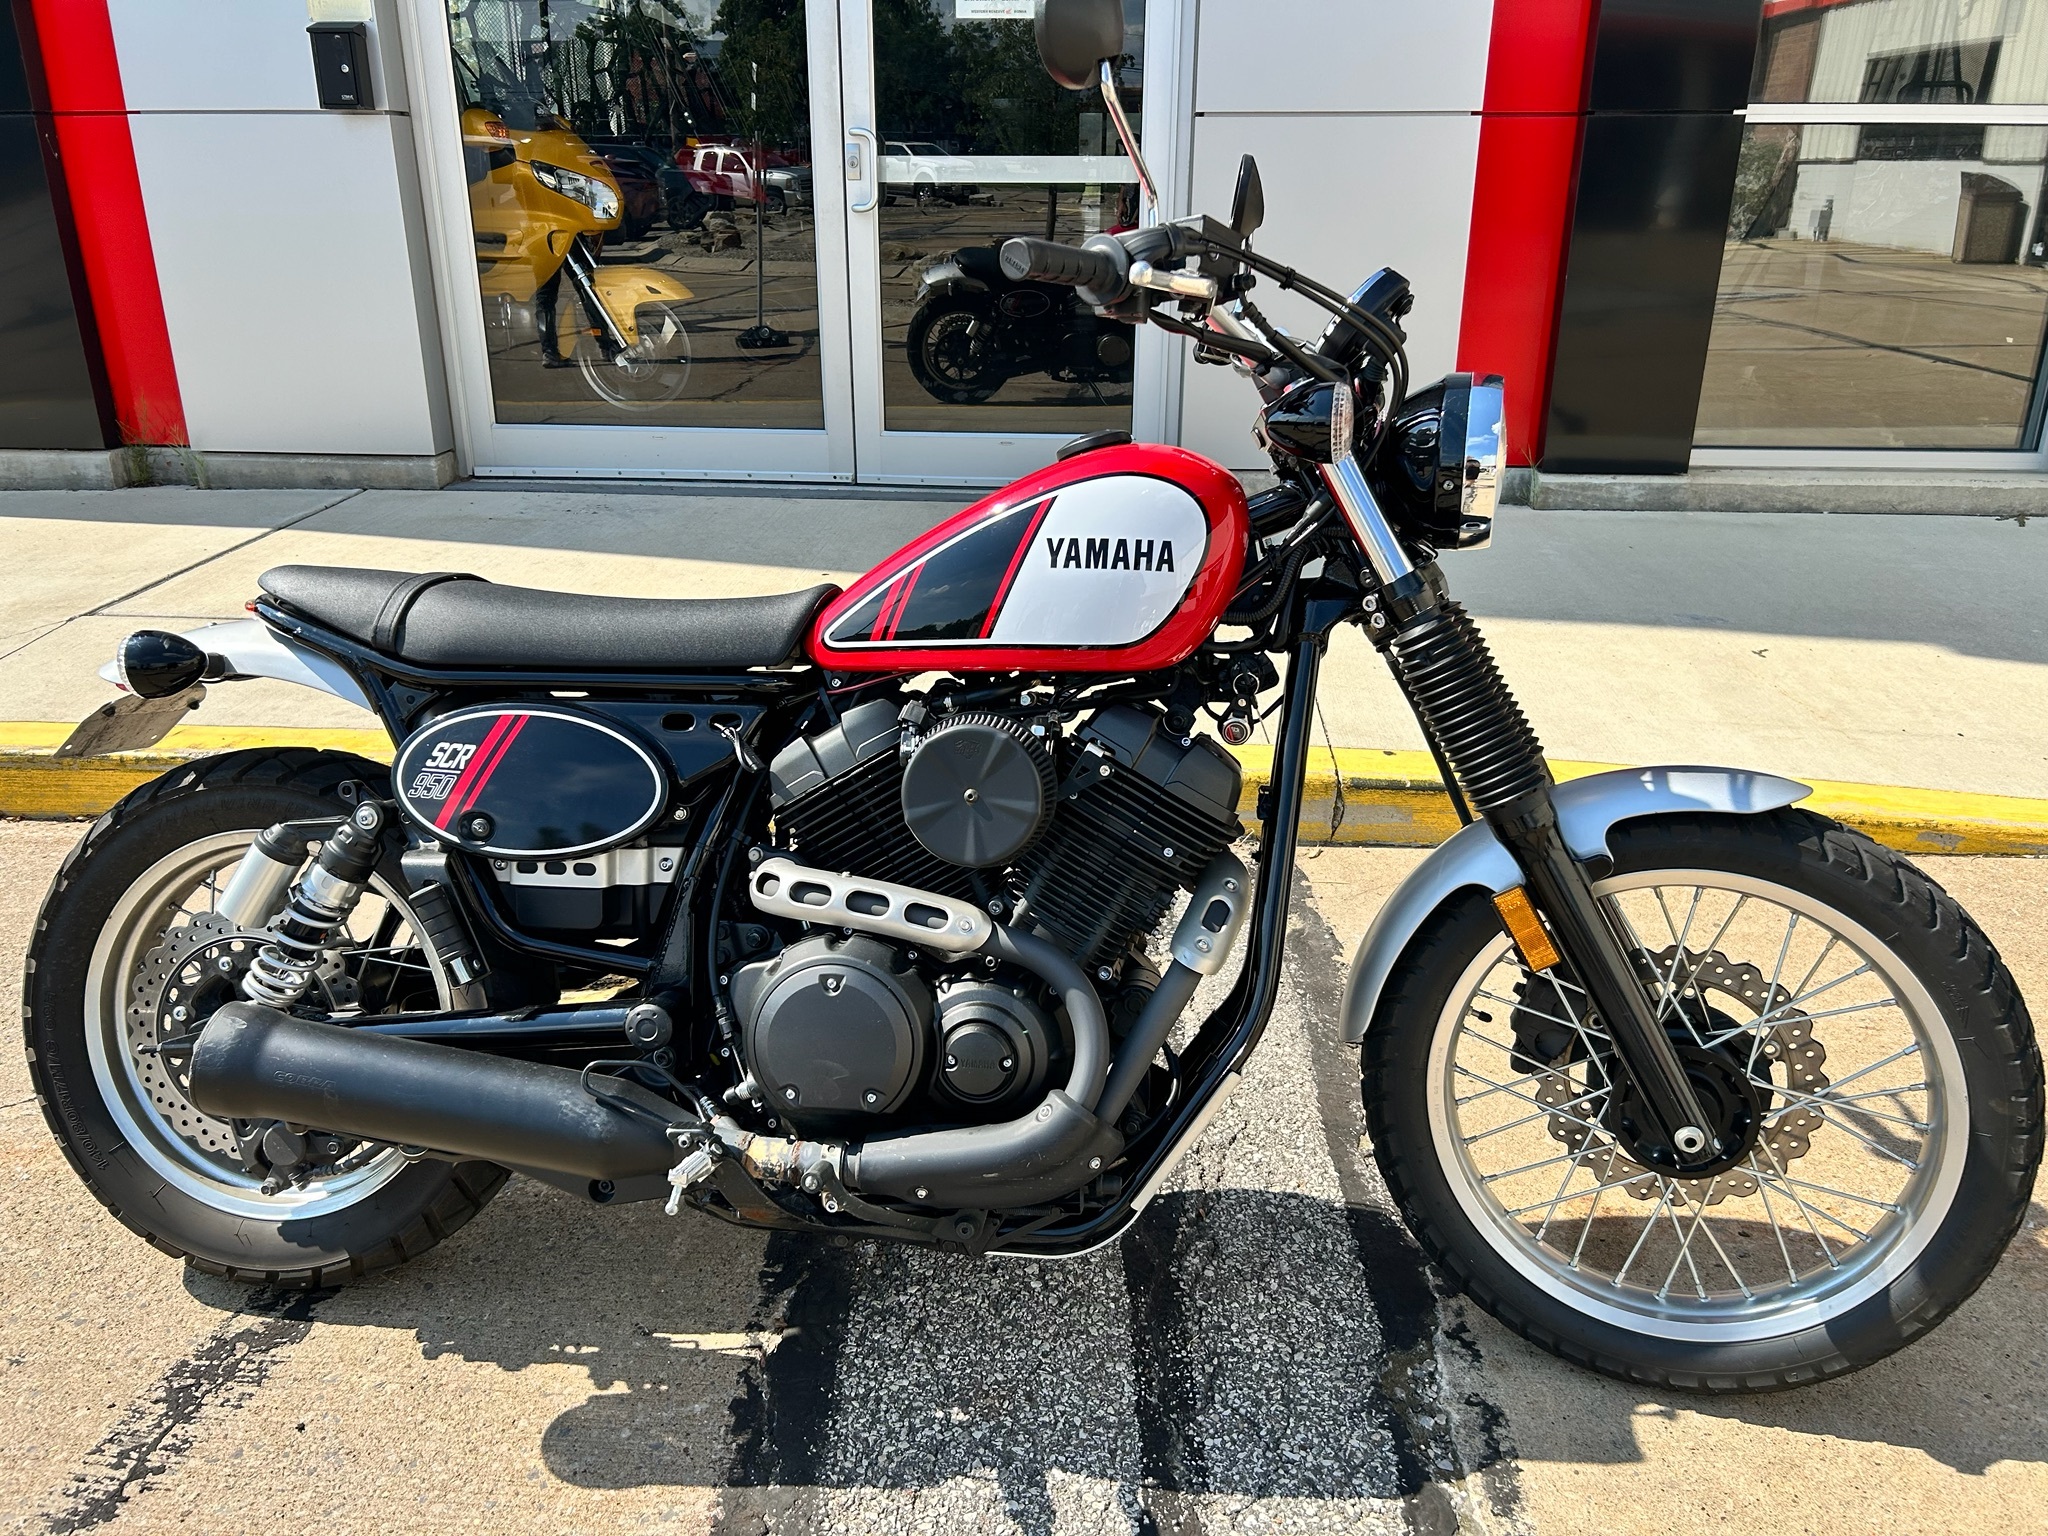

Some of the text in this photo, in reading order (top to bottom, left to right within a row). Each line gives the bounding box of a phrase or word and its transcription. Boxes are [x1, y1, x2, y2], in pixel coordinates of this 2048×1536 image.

[1046, 537, 1175, 573] YAMAHA
[425, 741, 477, 770] SCR
[407, 773, 458, 801] 950
[960, 1058, 996, 1070] YAMAHA
[273, 1069, 337, 1090] COBRA
